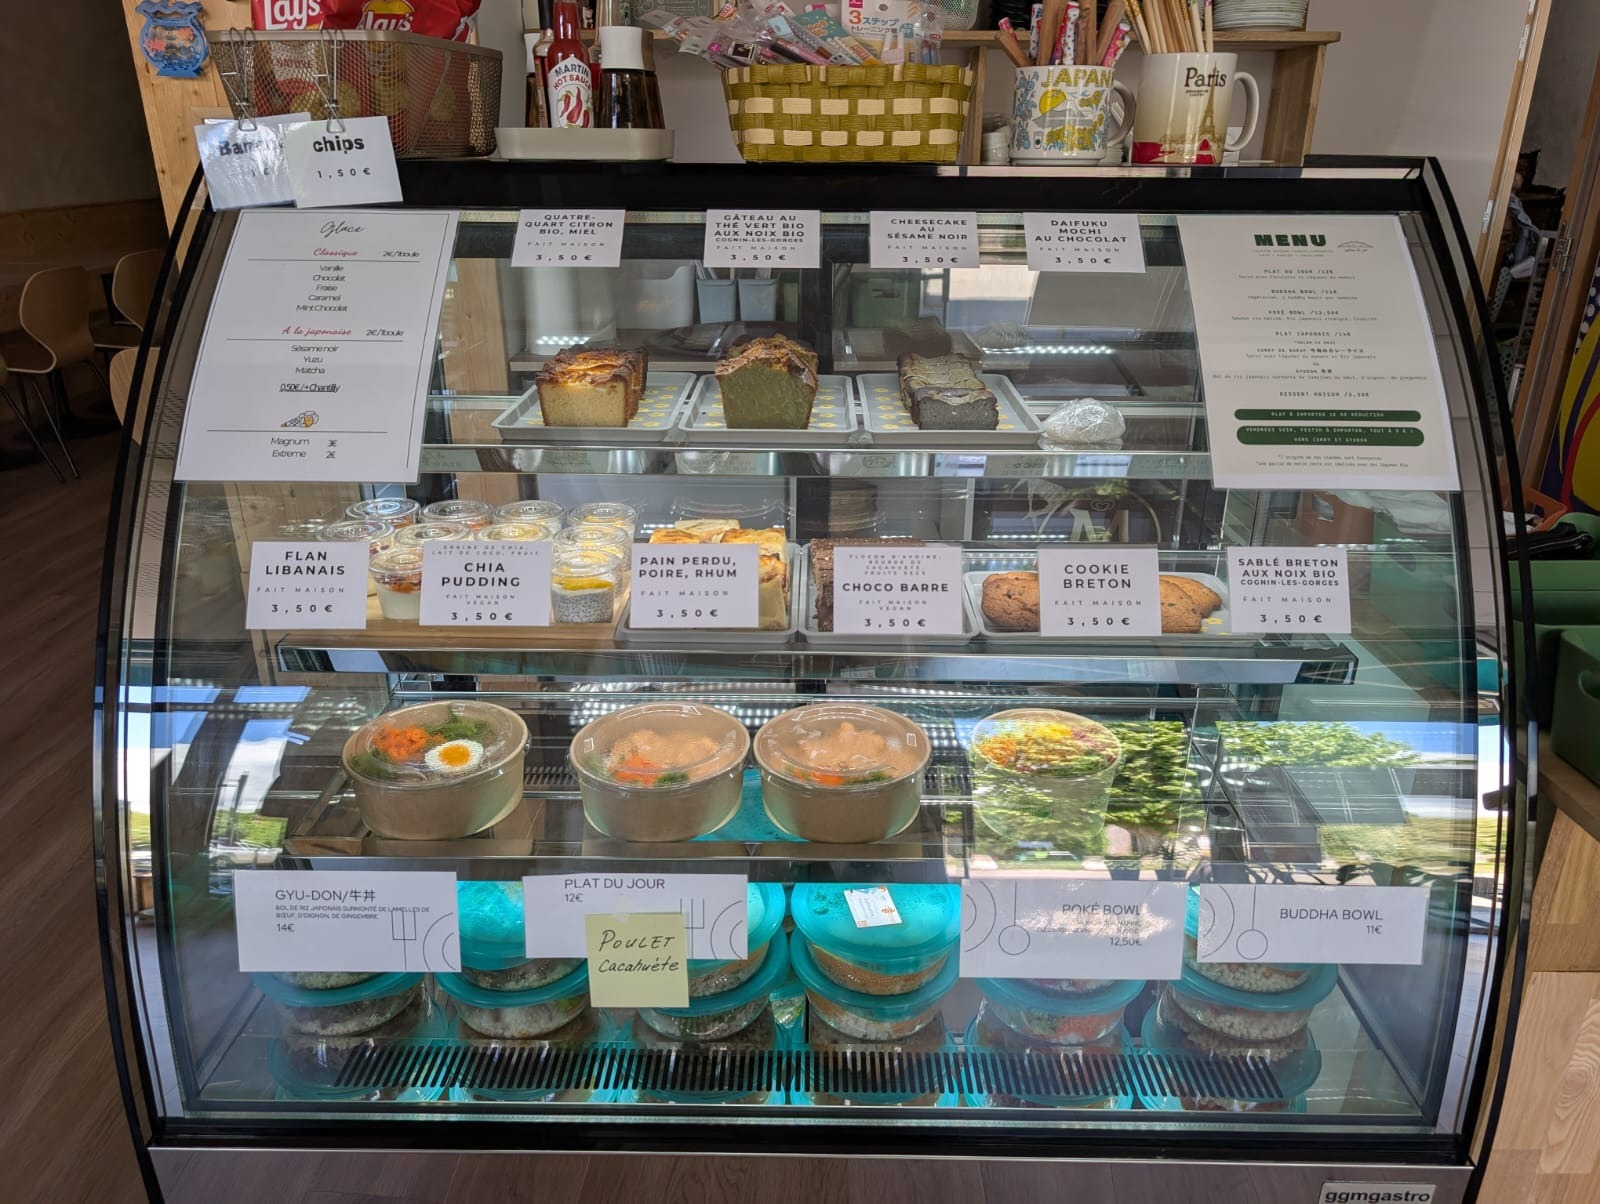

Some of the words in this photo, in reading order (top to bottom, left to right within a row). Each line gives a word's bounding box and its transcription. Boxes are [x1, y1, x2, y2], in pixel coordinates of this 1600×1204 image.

[554, 64, 589, 77] MARTIN
[1041, 68, 1111, 88] JAPAN
[1184, 67, 1227, 88] Paris
[554, 76, 568, 90] HOT
[313, 136, 364, 155] chips
[724, 213, 774, 221] GÂTEAU
[320, 220, 365, 238] Glace
[715, 221, 740, 229] THÉ
[1254, 234, 1327, 247] MENU
[313, 248, 358, 257] Classique
[294, 326, 303, 335] la
[270, 437, 310, 446] Magnum
[285, 551, 328, 561] FLAN
[464, 562, 504, 572] CHIA
[640, 556, 675, 566] PAIN
[682, 556, 736, 568] PERDU,
[1238, 557, 1279, 567] SABLÉ
[1286, 559, 1338, 567] BRETON
[265, 565, 345, 575] LIBANAIS
[639, 569, 689, 580] POIRE,
[695, 569, 737, 578] RHUM
[1064, 564, 1130, 575] COOKIE
[1242, 570, 1270, 578] AUX
[1275, 570, 1307, 578] NOIX
[1313, 570, 1336, 578] BIO
[441, 577, 520, 586] PUDDING
[1064, 578, 1132, 588] BRETON
[842, 583, 893, 592] CHOCO
[900, 583, 948, 592] BARRE
[564, 878, 598, 890] PLAT
[604, 878, 622, 890] DU
[626, 878, 665, 890] JOUR
[564, 894, 583, 902] 12€
[1062, 901, 1100, 915] POKÉ
[1104, 904, 1140, 915] BOWL
[1280, 909, 1338, 920] BUDDHA
[1342, 909, 1383, 920] BOWL
[277, 924, 294, 932] 14€
[1366, 925, 1382, 935] 11€
[1110, 937, 1142, 946] 12,50€
[1325, 1190, 1430, 1204] ggmgastro
